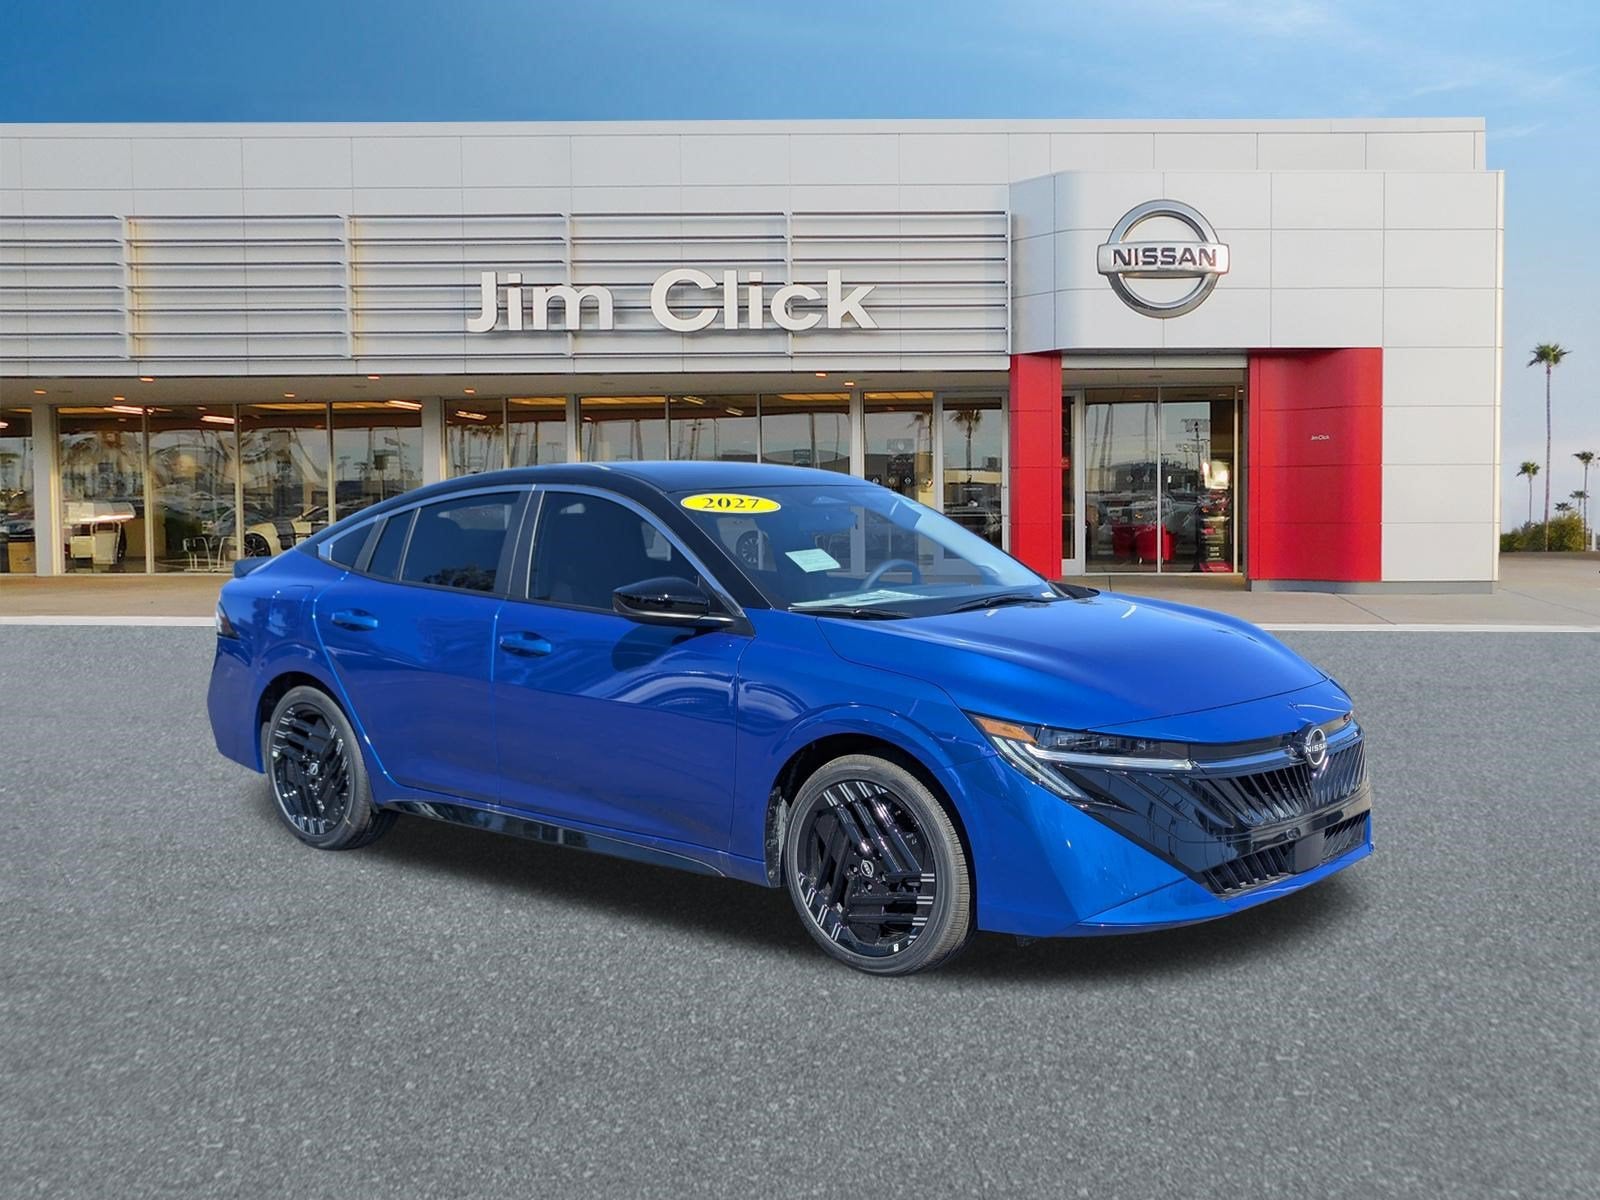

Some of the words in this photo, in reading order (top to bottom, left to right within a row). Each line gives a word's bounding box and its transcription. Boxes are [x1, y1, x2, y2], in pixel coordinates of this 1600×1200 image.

[1112, 247, 1217, 267] NISSAN
[466, 270, 614, 333] Jim
[650, 268, 879, 332] Click
[703, 497, 760, 510] 2027
